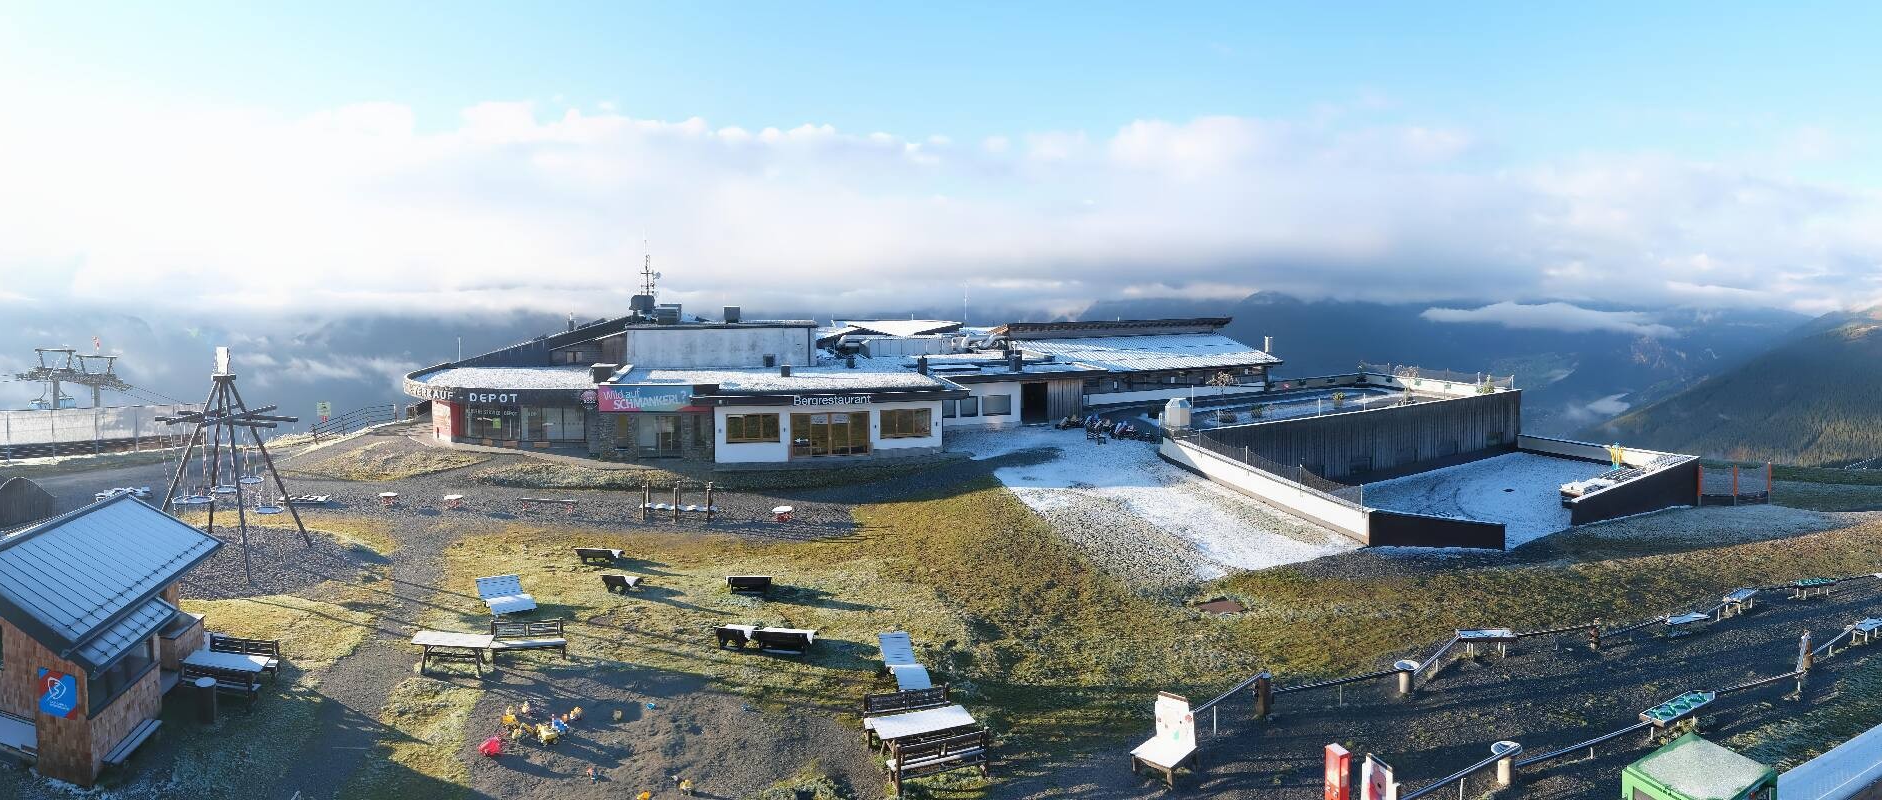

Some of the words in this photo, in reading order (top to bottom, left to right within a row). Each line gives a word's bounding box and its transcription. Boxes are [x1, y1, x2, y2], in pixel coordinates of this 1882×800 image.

[469, 392, 518, 403] DEPOT
[603, 389, 624, 400] Wild
[625, 387, 641, 399] auf
[793, 395, 872, 406] Bergrestaurant
